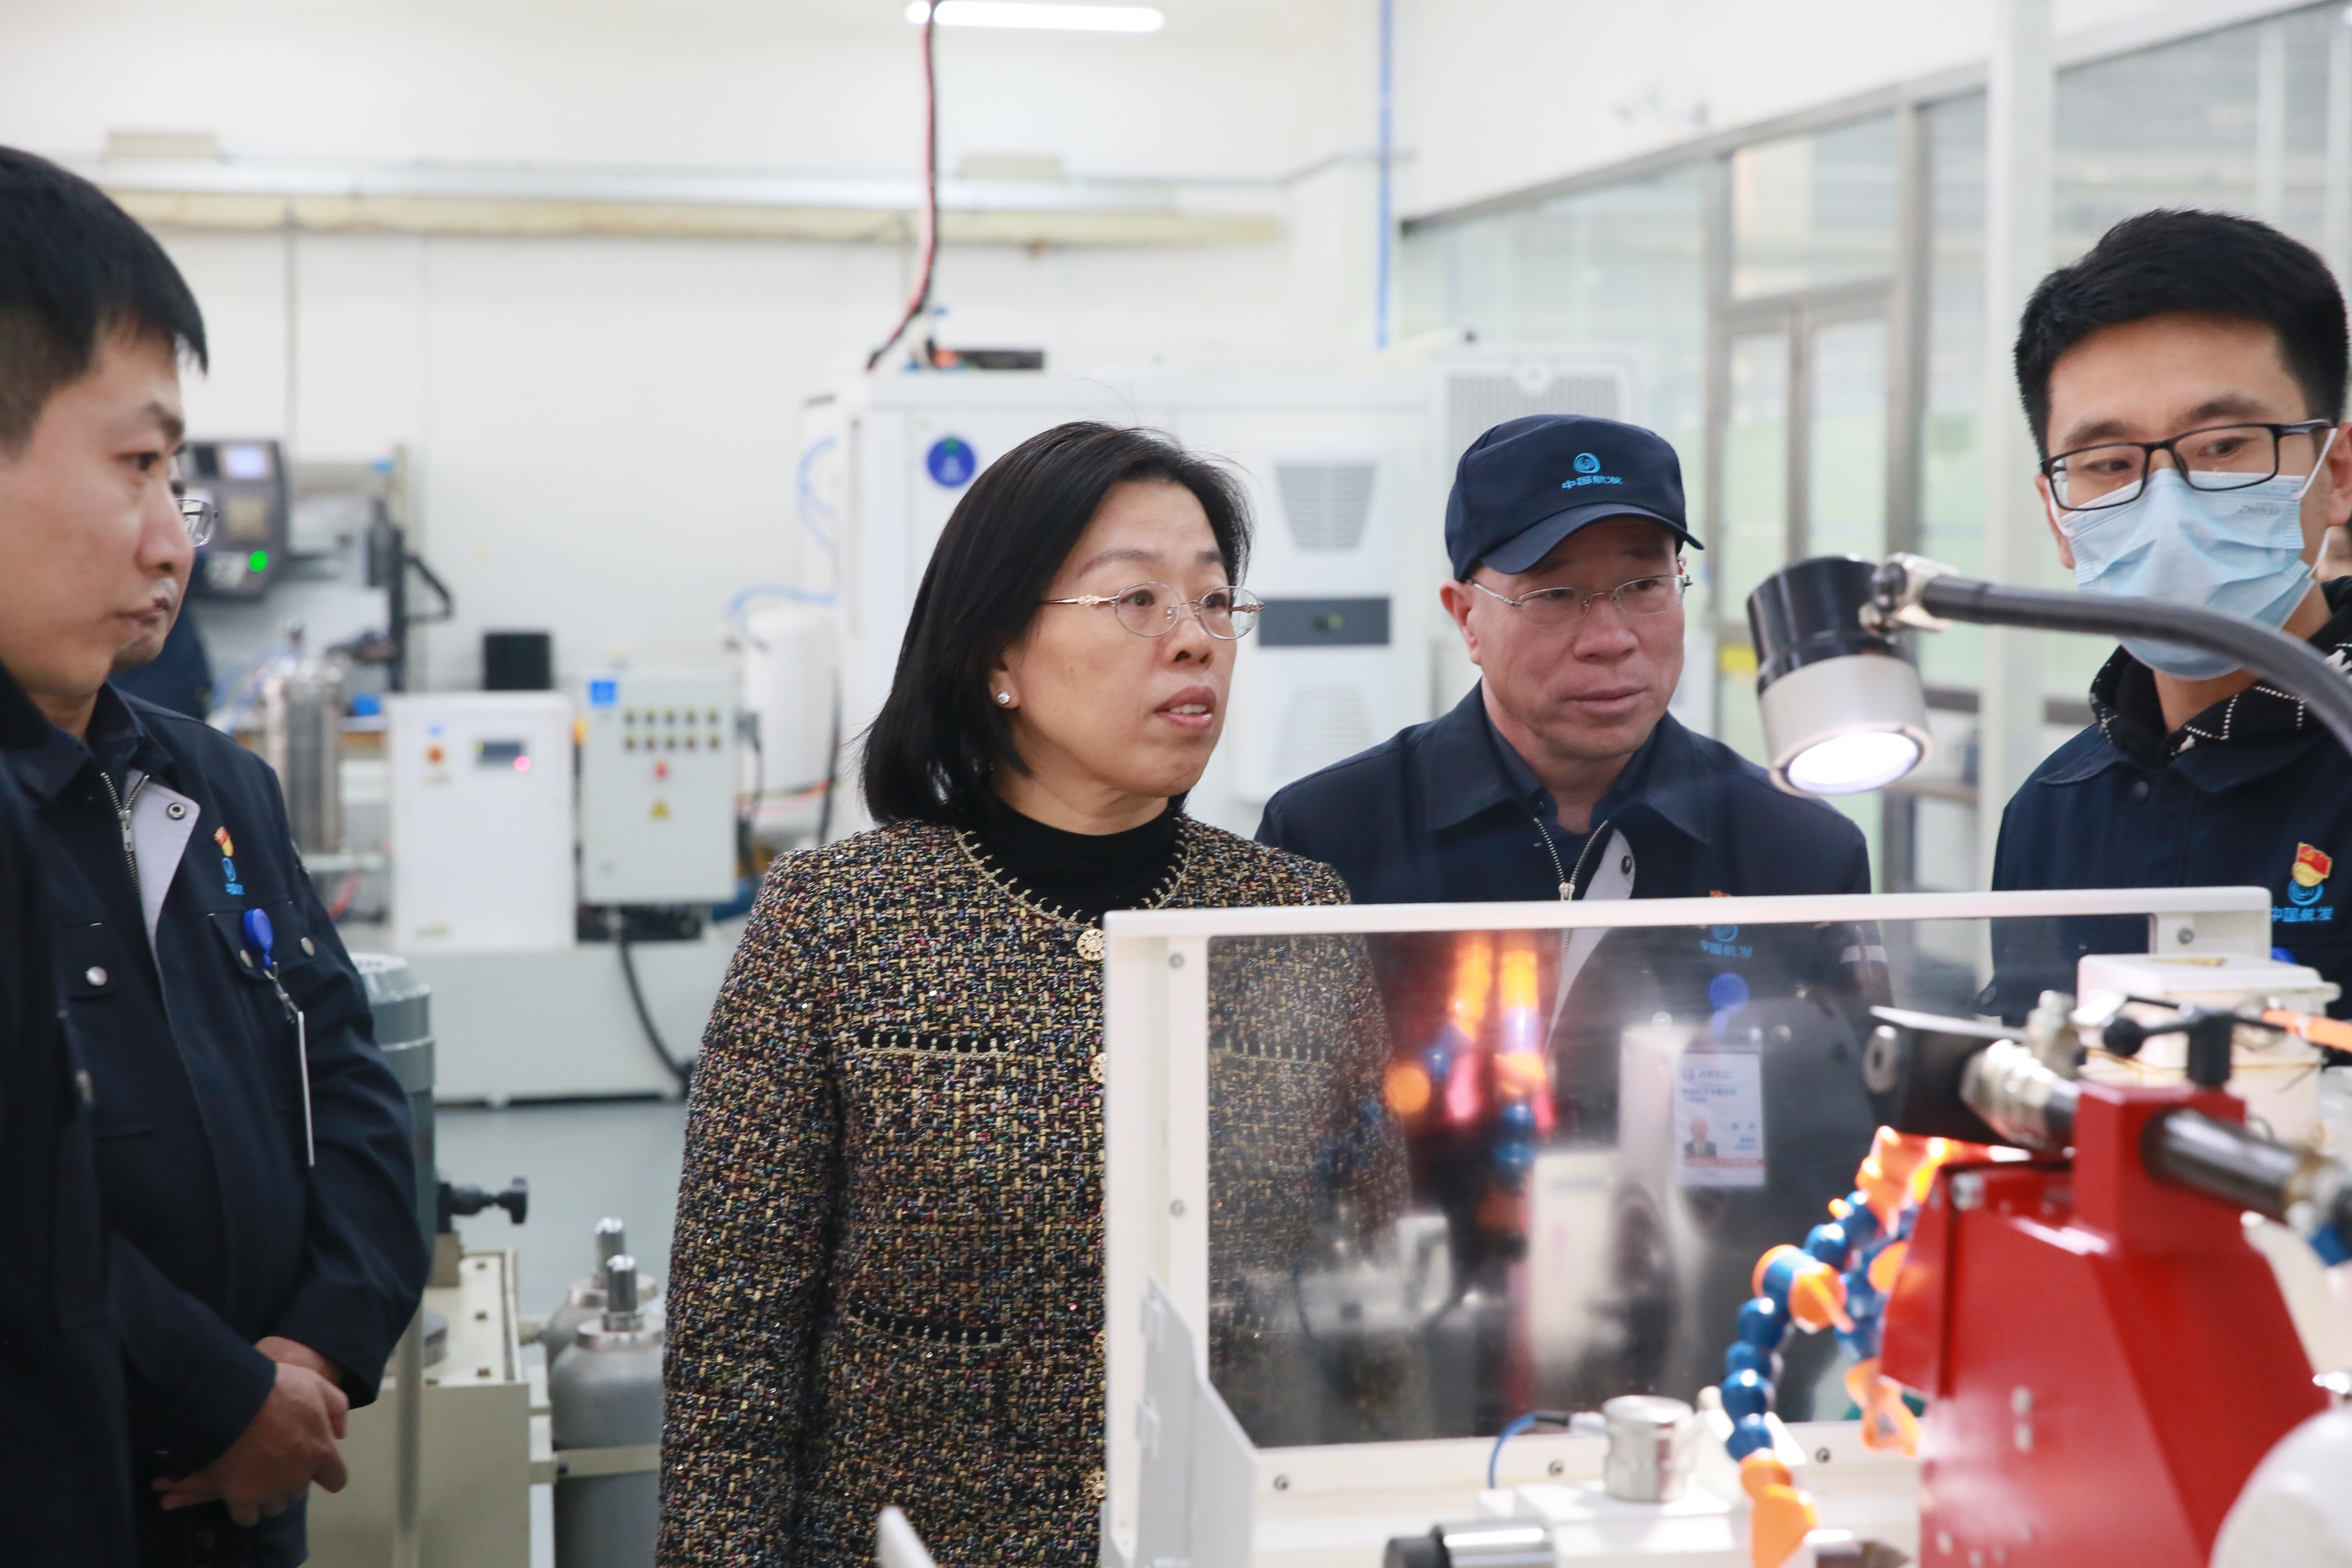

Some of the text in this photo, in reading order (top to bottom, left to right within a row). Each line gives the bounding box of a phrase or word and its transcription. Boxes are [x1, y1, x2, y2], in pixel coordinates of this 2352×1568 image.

[1561, 475, 1623, 489] 中国航发
[2271, 906, 2333, 922] 中国航发
